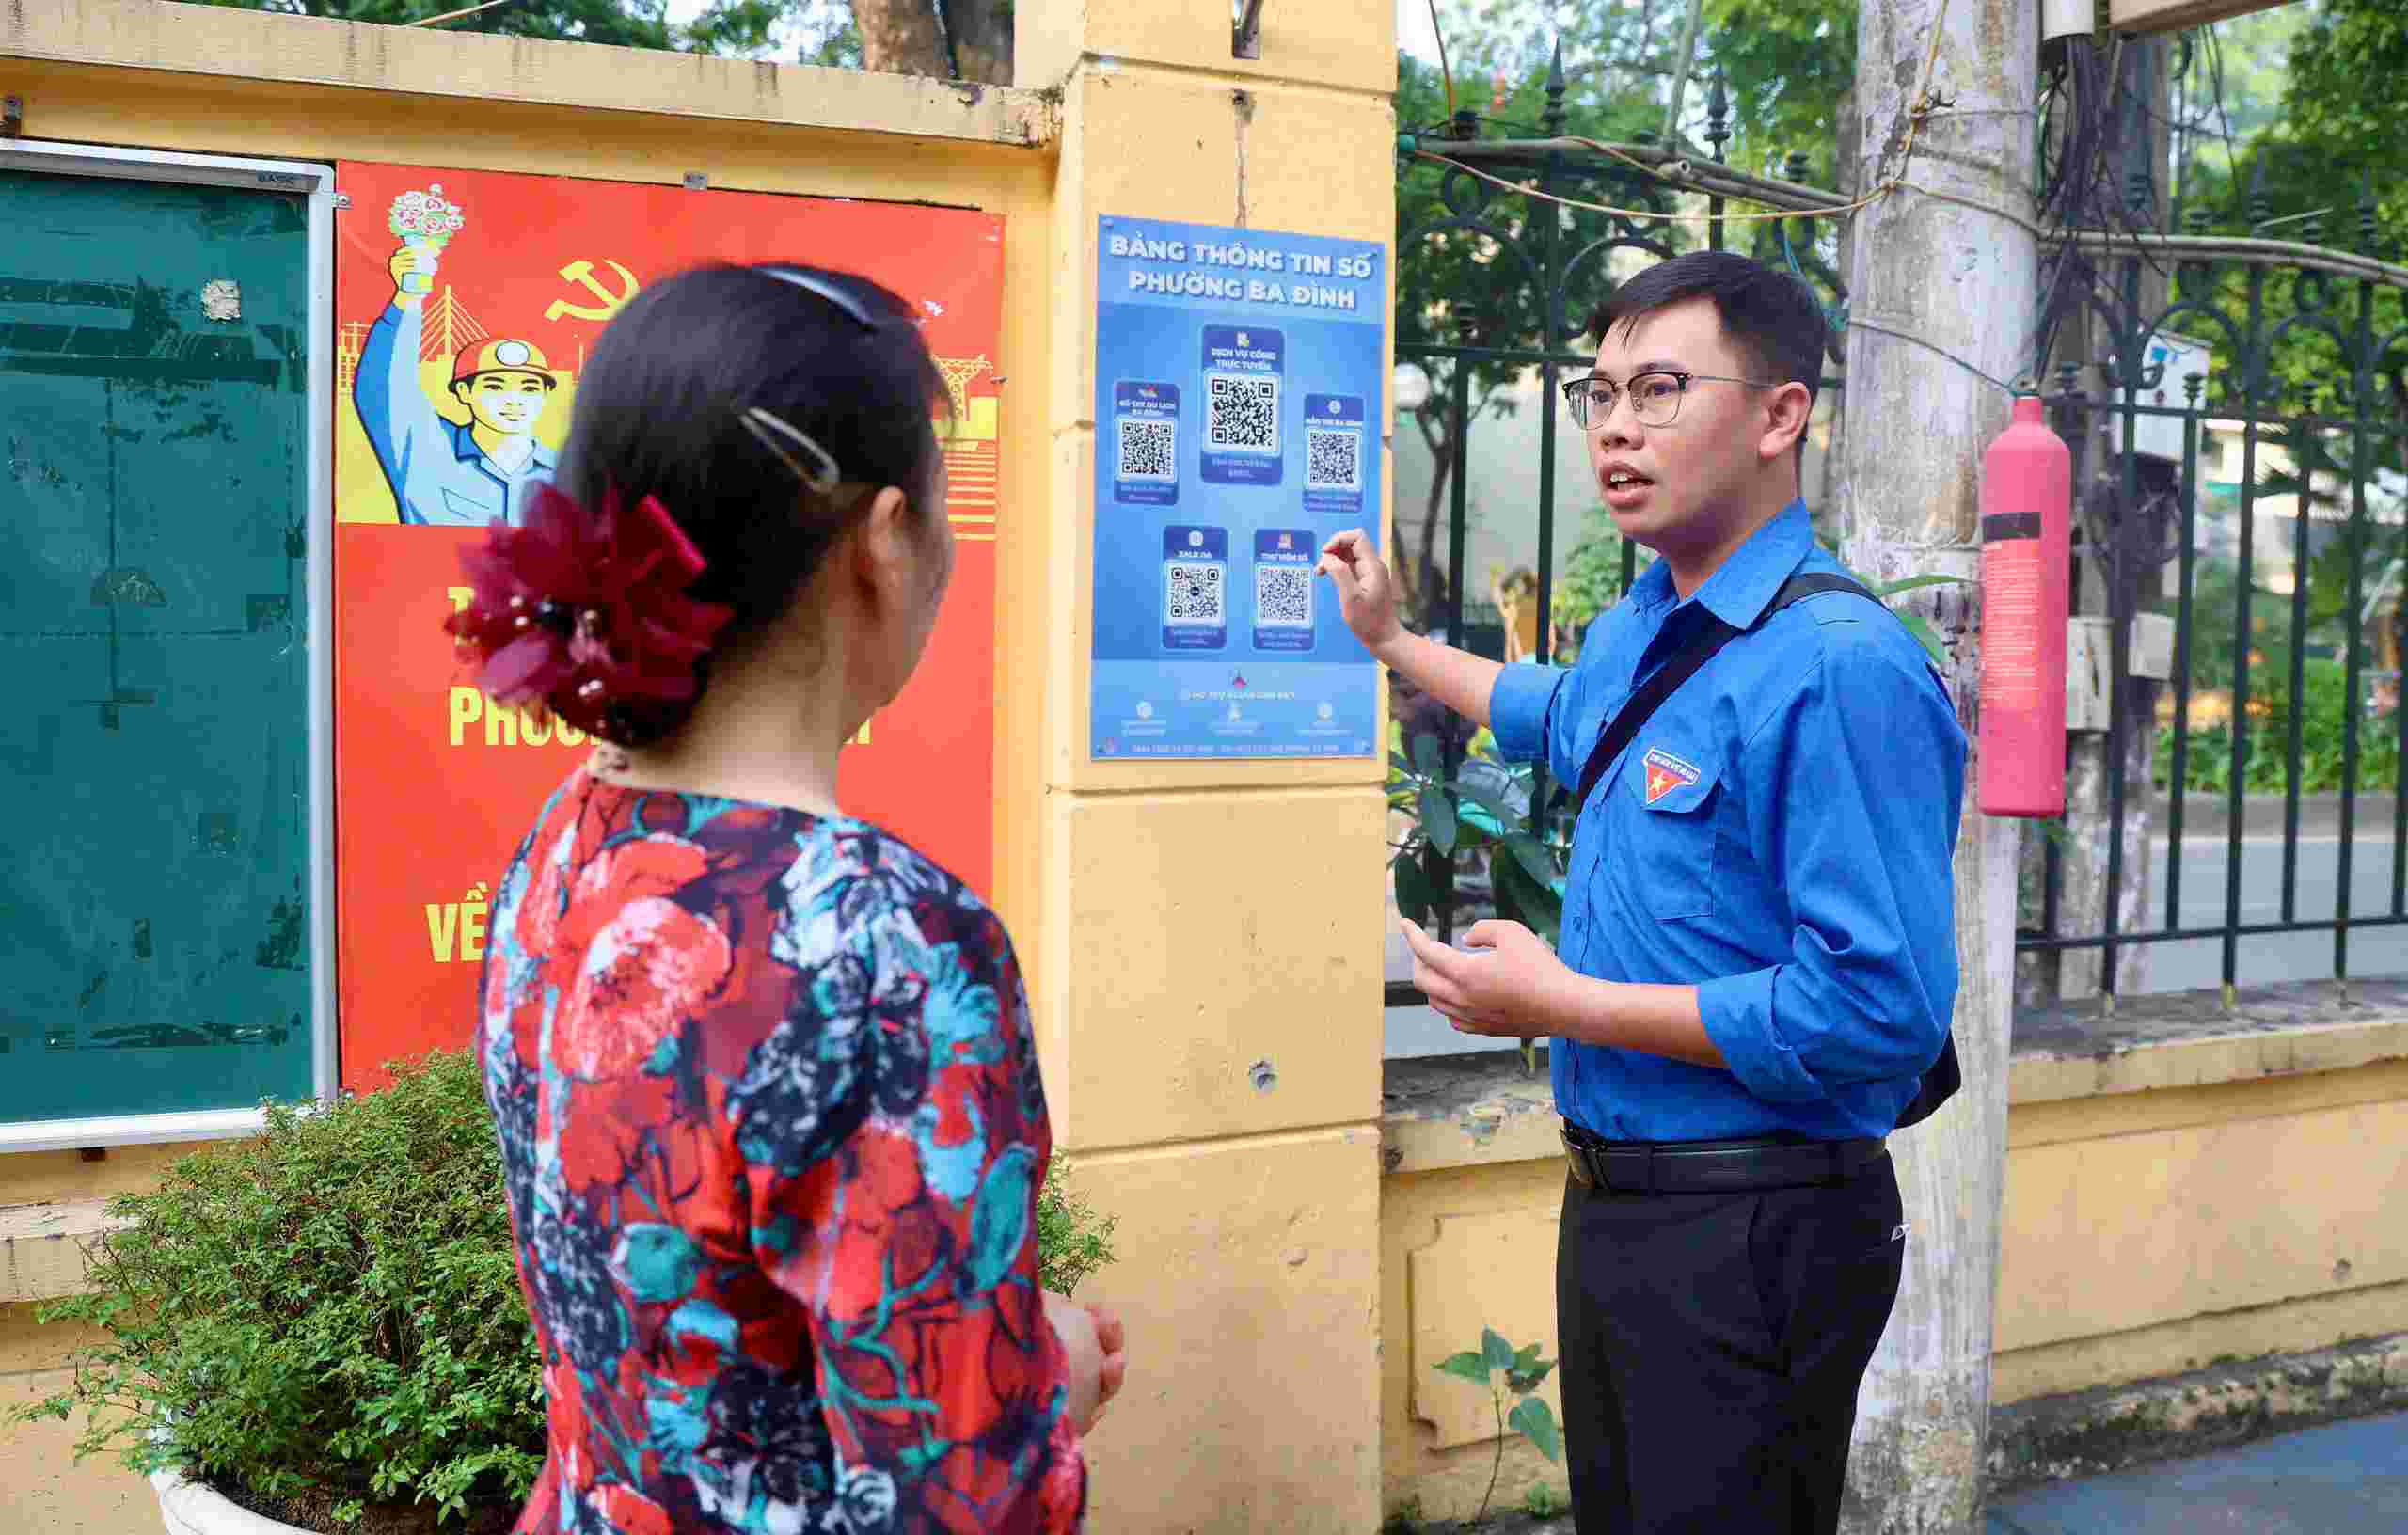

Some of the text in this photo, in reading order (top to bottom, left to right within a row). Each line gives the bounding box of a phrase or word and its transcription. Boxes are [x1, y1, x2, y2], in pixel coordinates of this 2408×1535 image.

[1110, 230, 1375, 279] BẢNG THÔNG TIN SỐ
[1128, 270, 1355, 309] PHƯỜNG BA ĐÌNH
